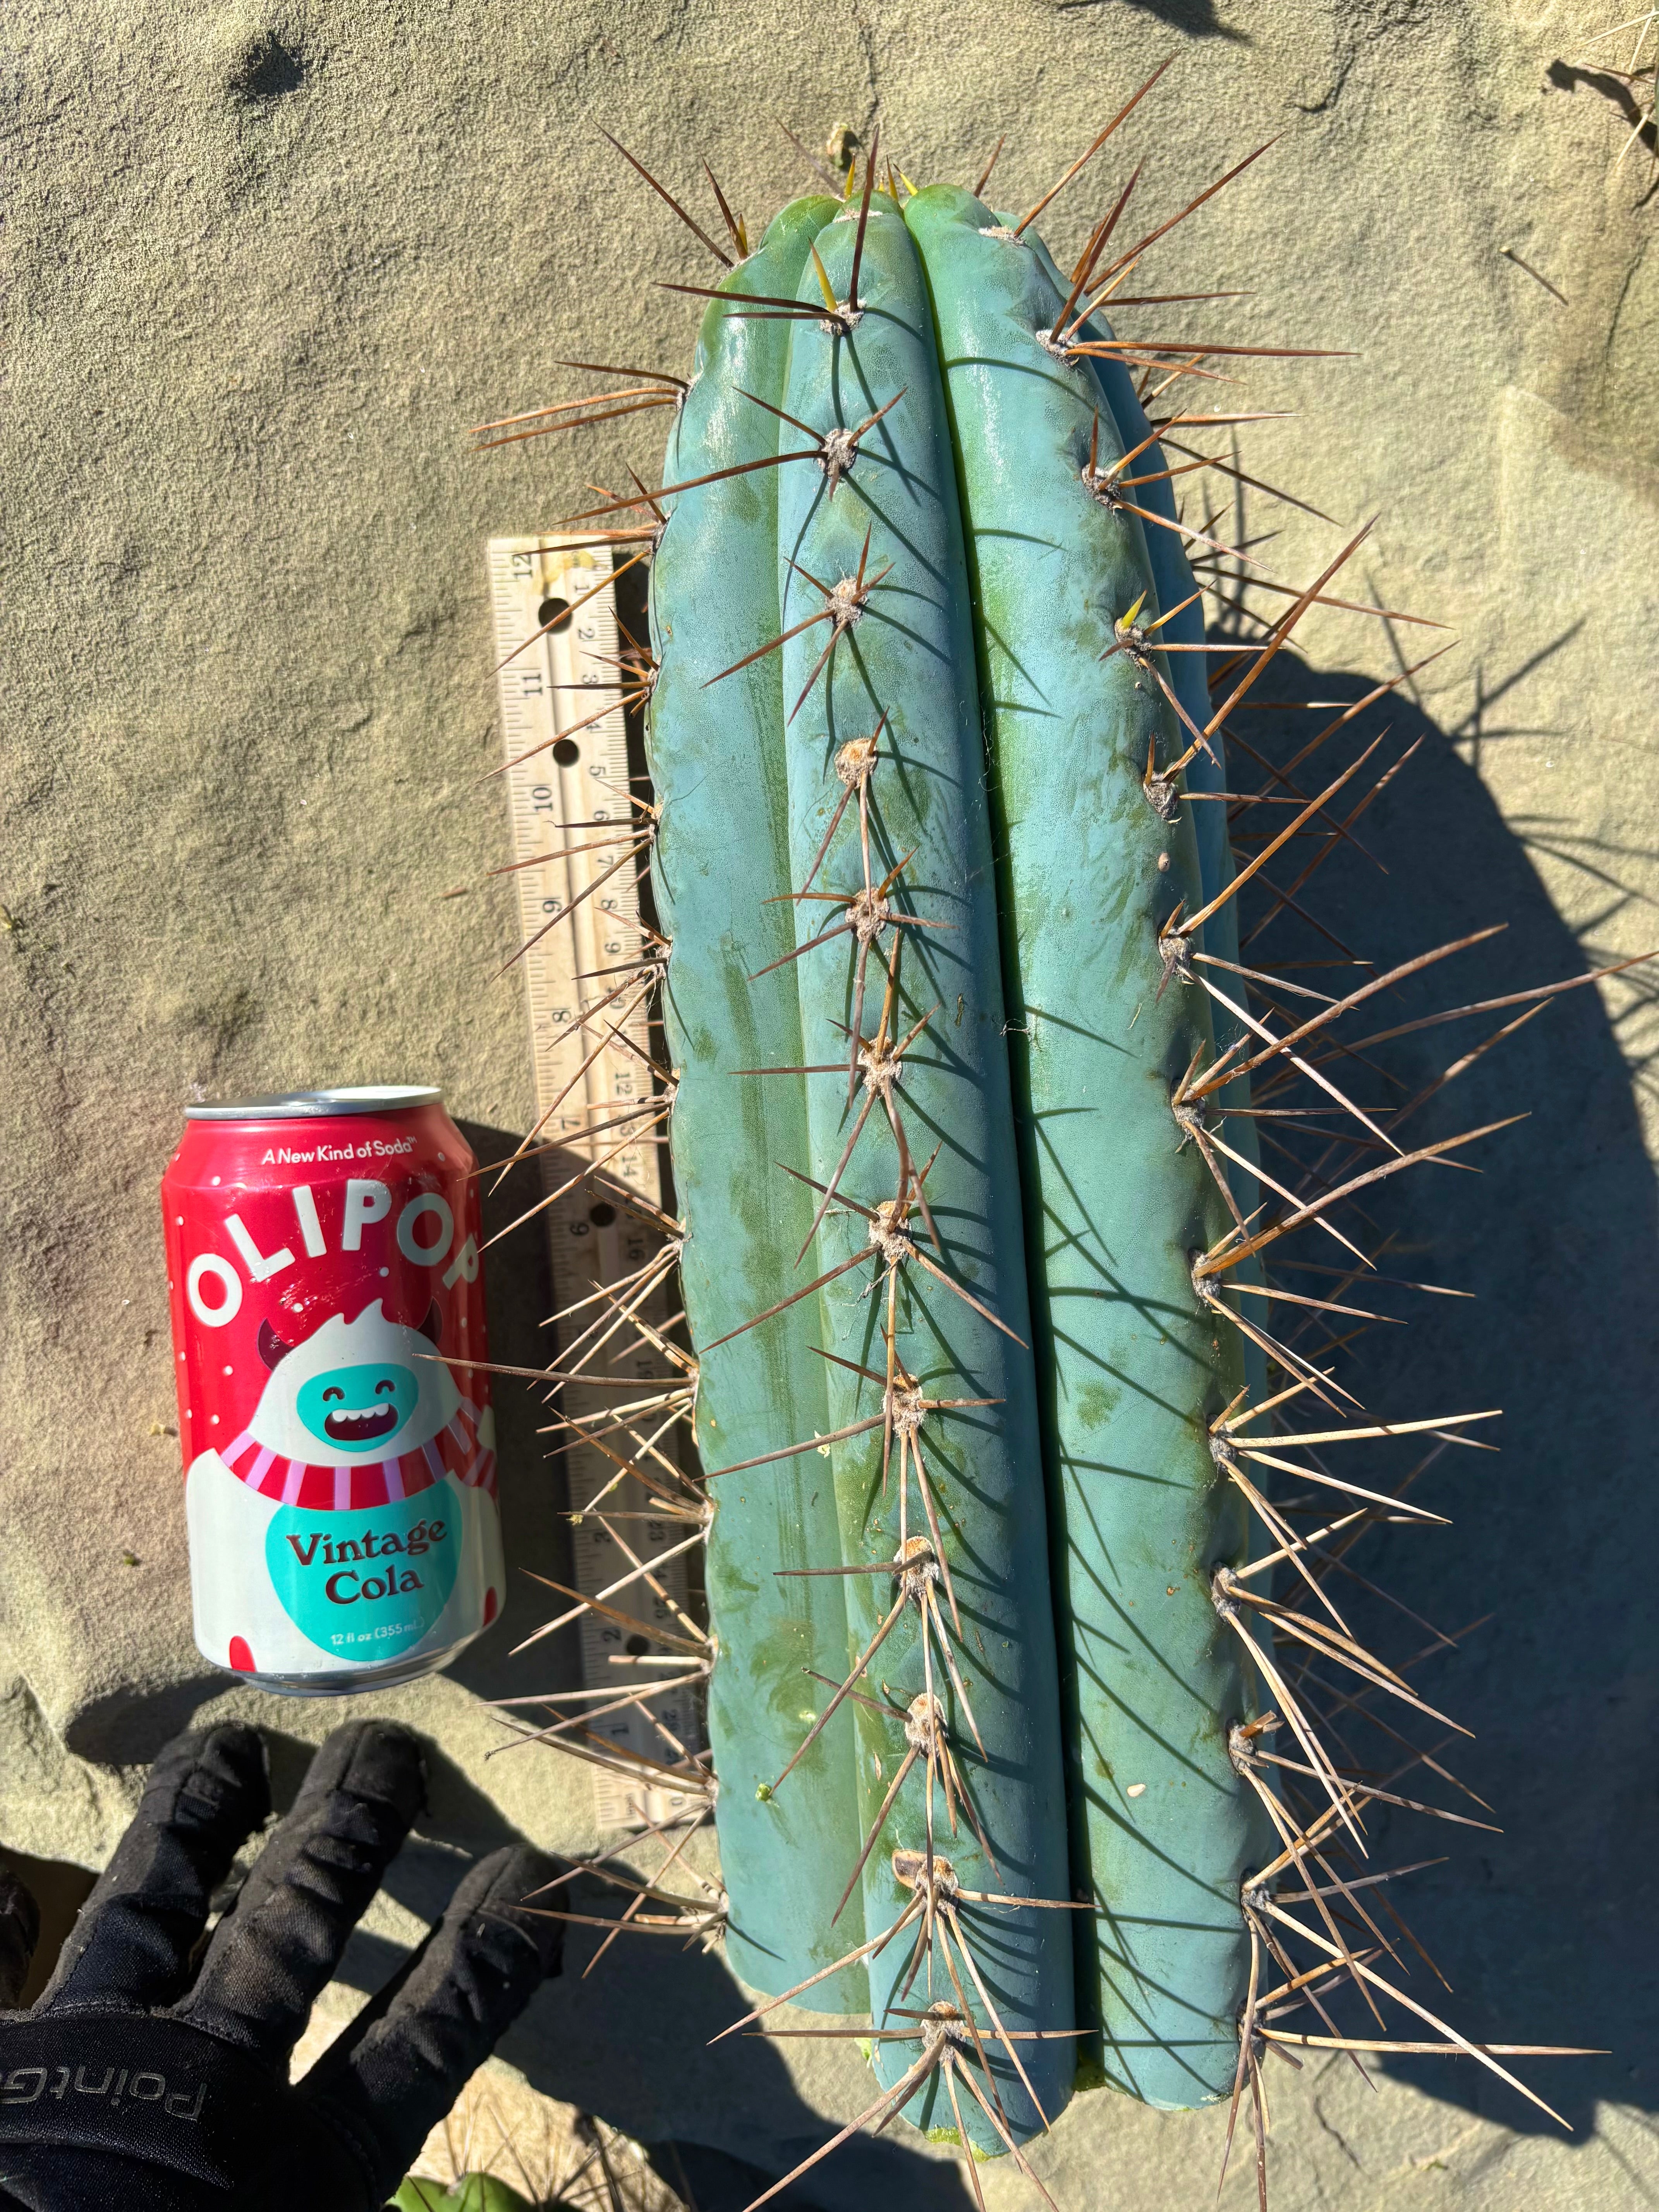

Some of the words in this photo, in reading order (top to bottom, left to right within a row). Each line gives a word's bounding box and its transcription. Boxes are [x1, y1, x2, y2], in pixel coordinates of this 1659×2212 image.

[512, 555, 533, 579] 12
[575, 584, 589, 592] 1
[578, 628, 595, 640] 2
[522, 673, 543, 696] 11
[582, 674, 599, 684] 3
[586, 721, 603, 732] 4
[589, 766, 606, 776] 5
[532, 787, 553, 811] 10
[597, 855, 613, 866] 7
[542, 900, 562, 914] 9
[601, 898, 618, 910] 8
[552, 1010, 572, 1022] 8
[615, 1072, 633, 1096] 12
[560, 1118, 580, 1131] 7
[261, 1148, 276, 1165] A
[278, 1147, 315, 1164] New
[317, 1143, 354, 1162] Kind
[357, 1141, 373, 1158] of
[622, 1156, 638, 1176] 14
[570, 1223, 589, 1236] 6
[187, 1179, 479, 1328] OLIPOP
[286, 1518, 448, 1566] Vintage
[325, 1568, 424, 1605] Cola
[330, 1633, 344, 1645] 12
[347, 1632, 355, 1643] fl
[357, 1633, 372, 1642] oz
[602, 1629, 622, 1642] 2
